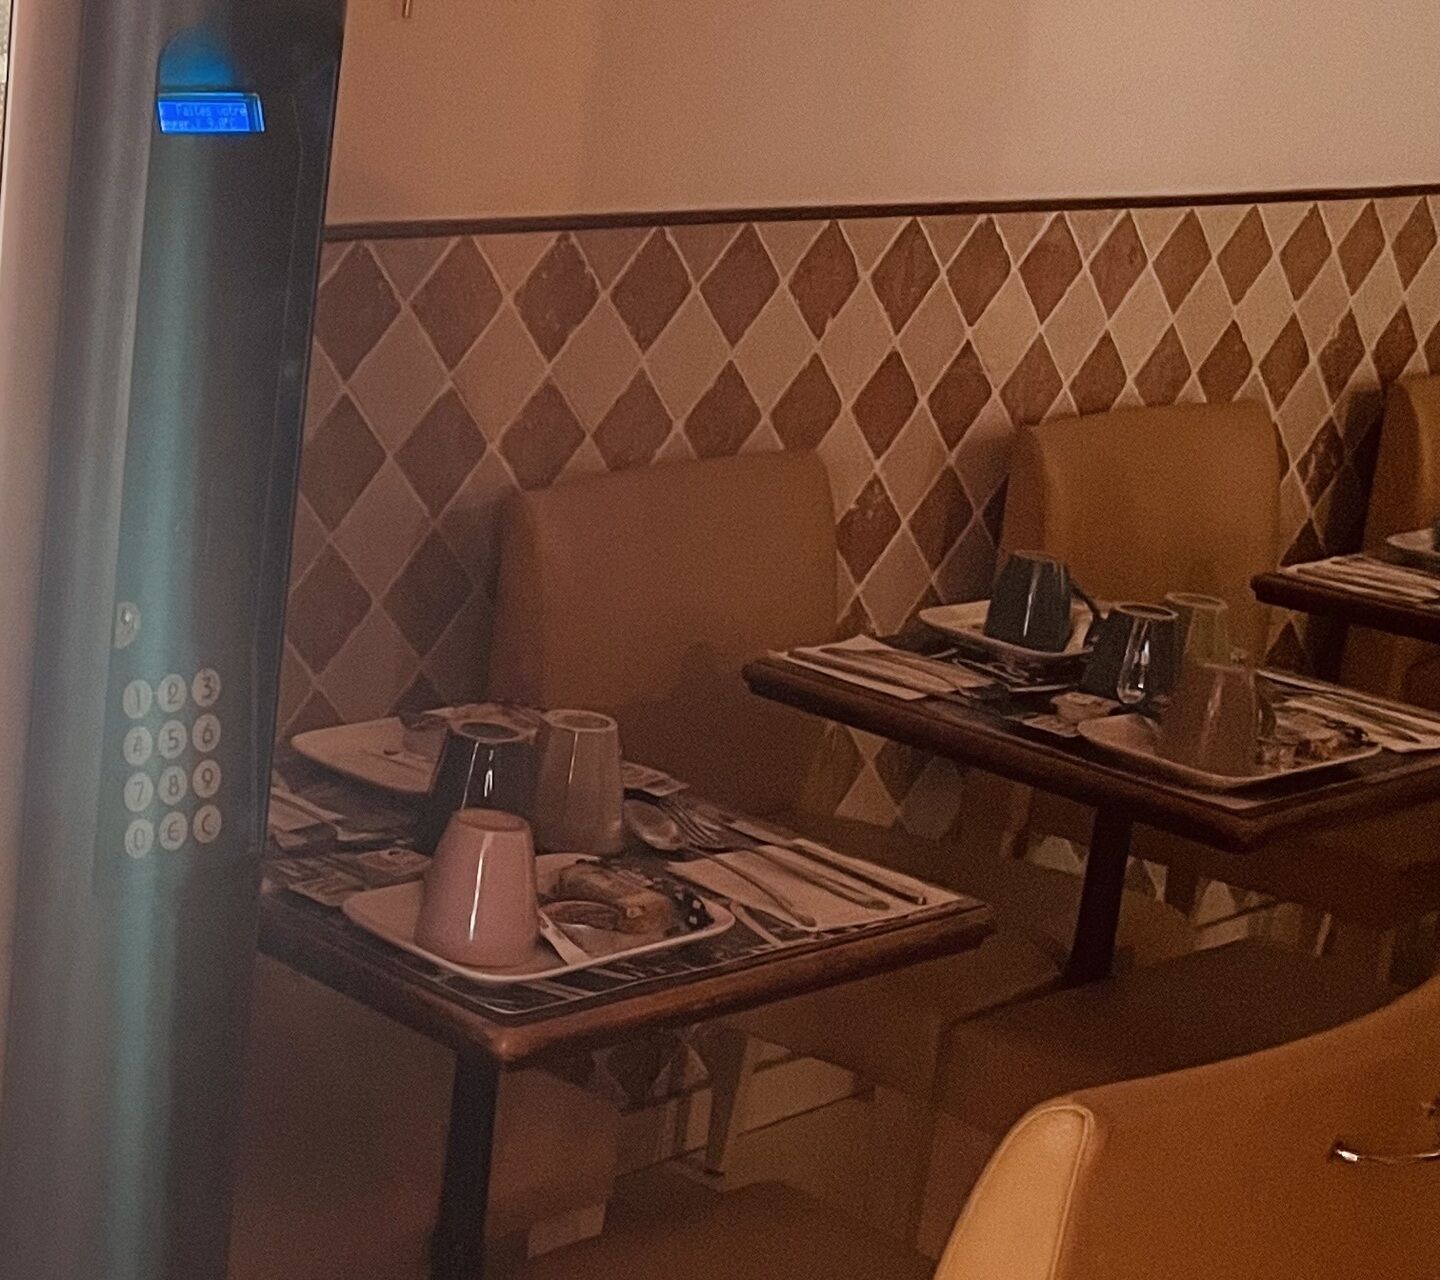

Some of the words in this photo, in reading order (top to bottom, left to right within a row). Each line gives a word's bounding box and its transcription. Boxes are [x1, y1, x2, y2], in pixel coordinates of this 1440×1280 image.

[167, 681, 179, 705] 2
[201, 676, 215, 699] 3
[167, 728, 180, 751] 5
[133, 780, 145, 803] 7
[168, 775, 180, 797] 8
[201, 768, 214, 791] 9
